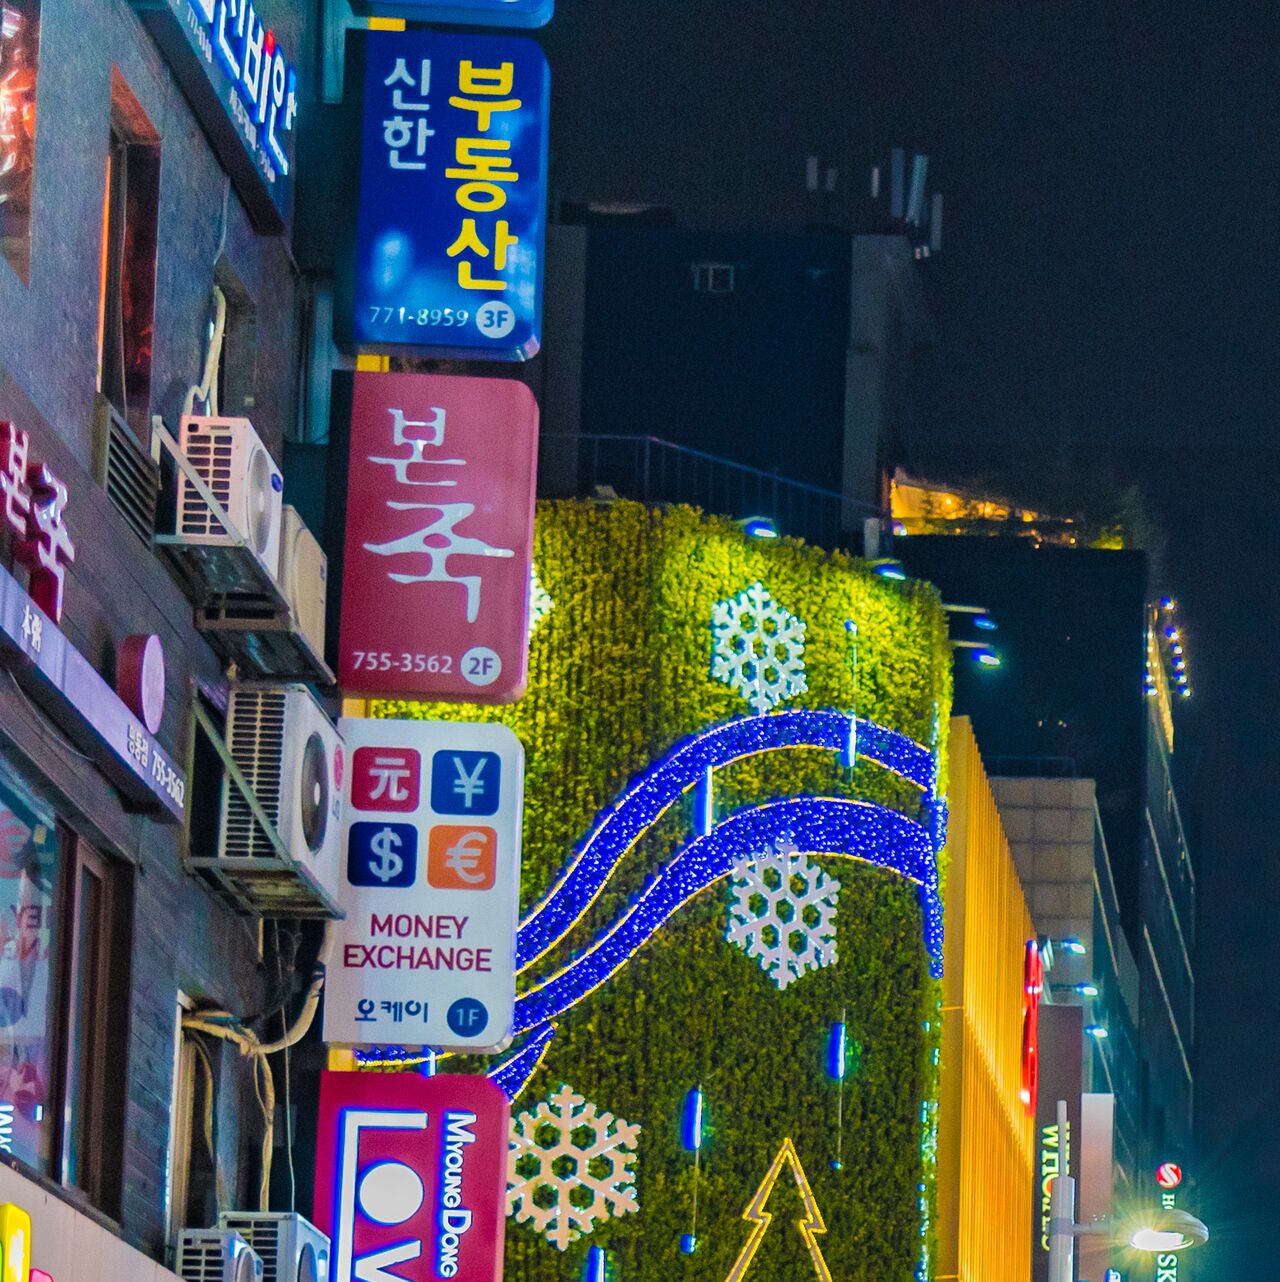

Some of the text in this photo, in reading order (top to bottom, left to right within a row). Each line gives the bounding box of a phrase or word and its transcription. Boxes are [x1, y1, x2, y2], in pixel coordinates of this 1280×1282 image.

[383, 57, 434, 171] 신한
[445, 60, 522, 291] 부동산
[370, 305, 469, 328] 771-8959
[483, 308, 509, 329] 3F
[363, 406, 515, 624] 본죽
[352, 650, 453, 674] 755-3562
[468, 655, 494, 676] 2F
[151, 749, 185, 809] 755-3562
[370, 911, 469, 940] MONEY
[343, 943, 492, 973] EXCHANGE
[353, 997, 430, 1024] 오케이
[454, 1006, 481, 1030] 1F
